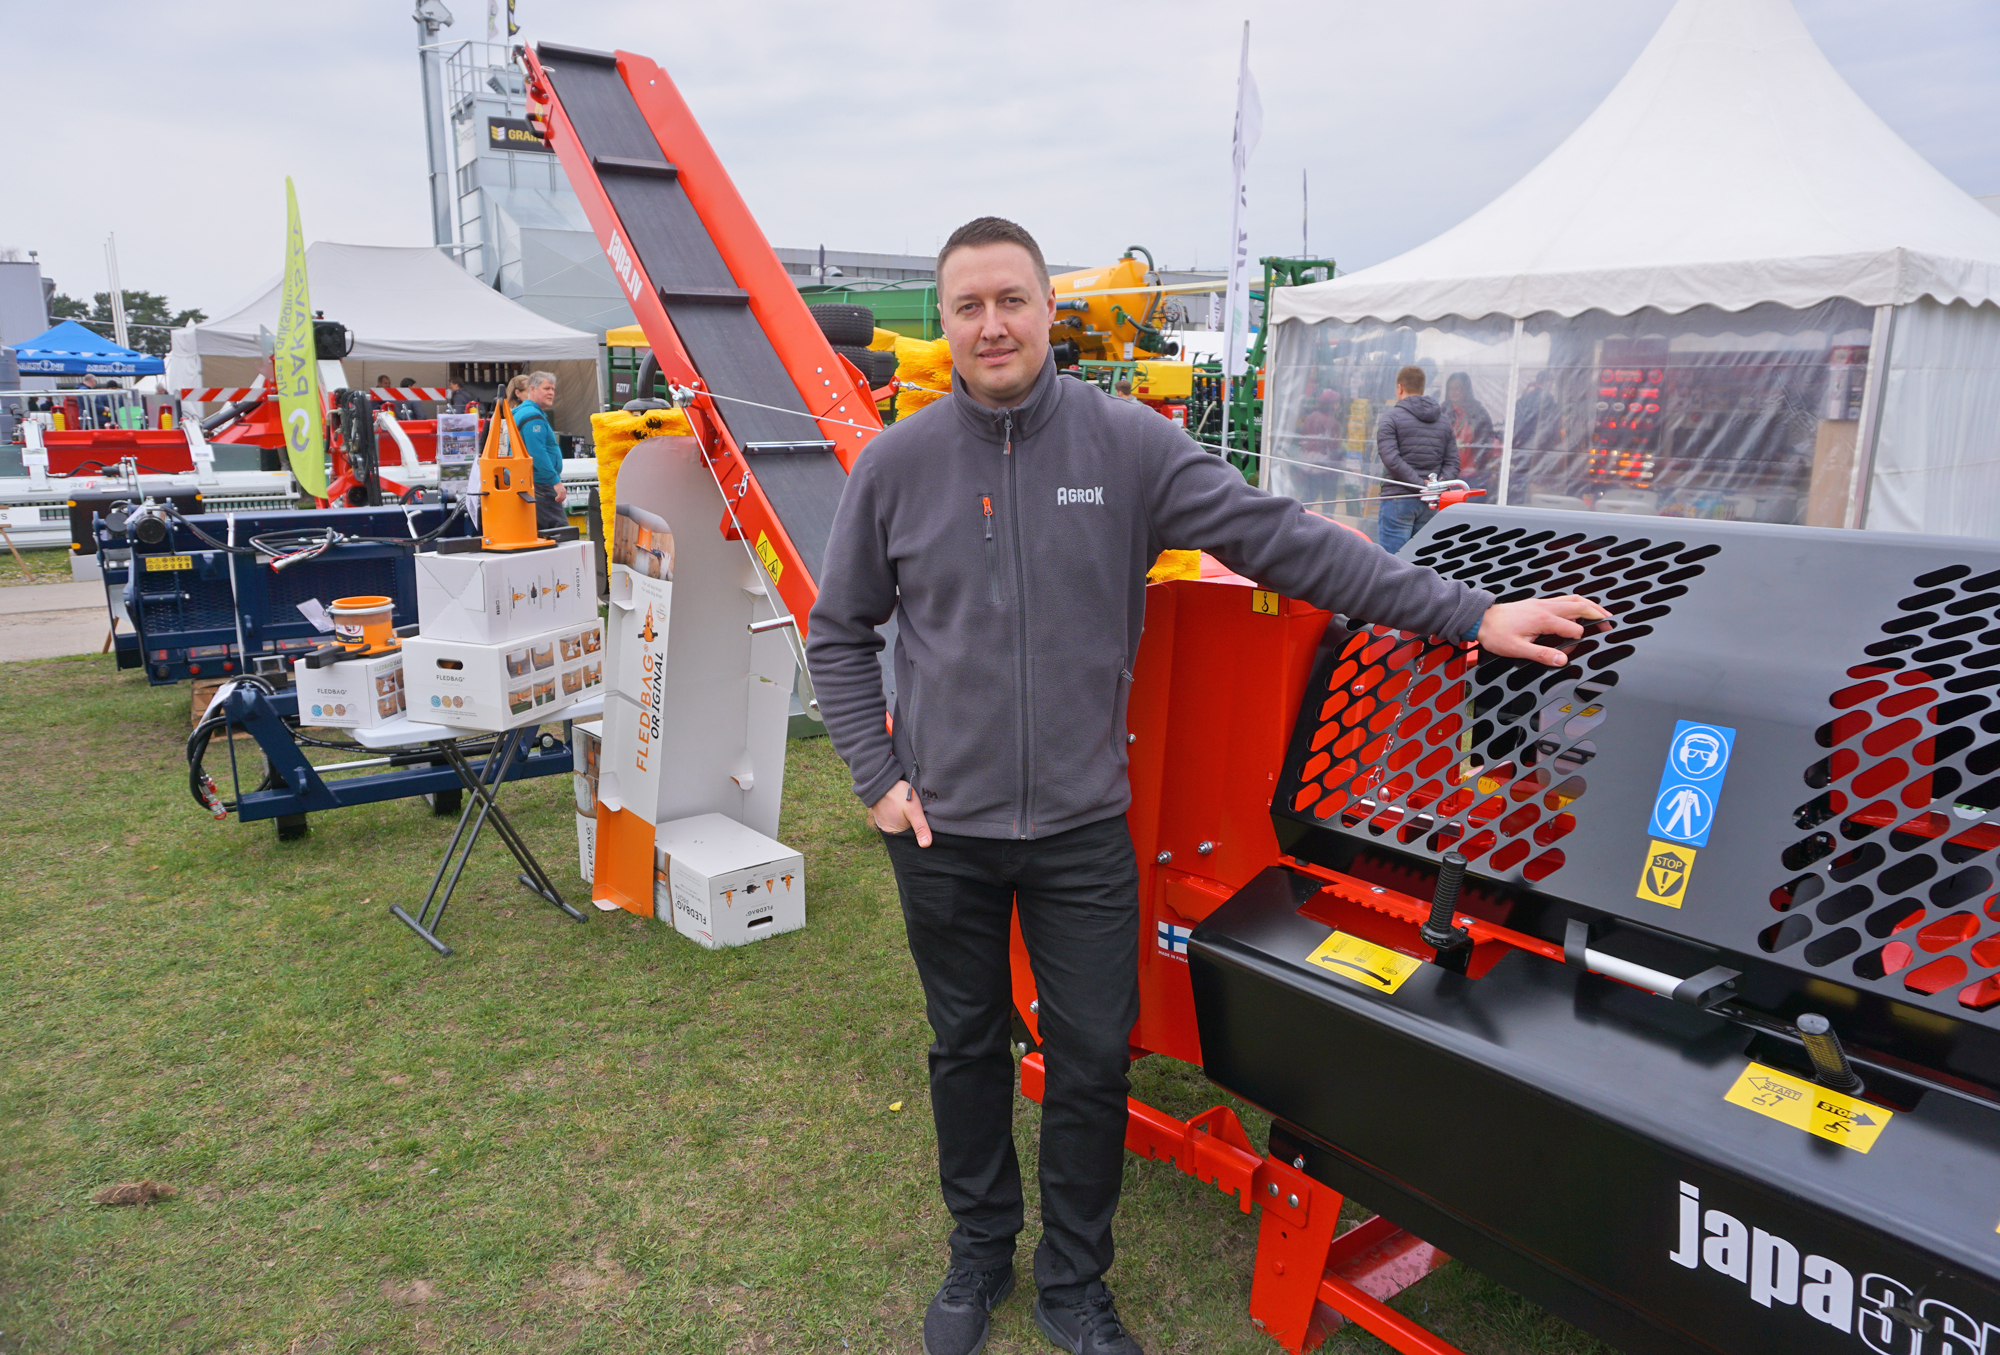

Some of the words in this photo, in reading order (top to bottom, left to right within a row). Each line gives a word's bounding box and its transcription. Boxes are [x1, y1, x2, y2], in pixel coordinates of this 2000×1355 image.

[651, 652, 664, 740] ORIGINAL
[1655, 856, 1683, 870] STOP
[1158, 950, 1170, 958] MADE
[1176, 955, 1189, 963] FINLA
[1765, 1081, 1802, 1101] START
[1820, 1101, 1858, 1120] STOP
